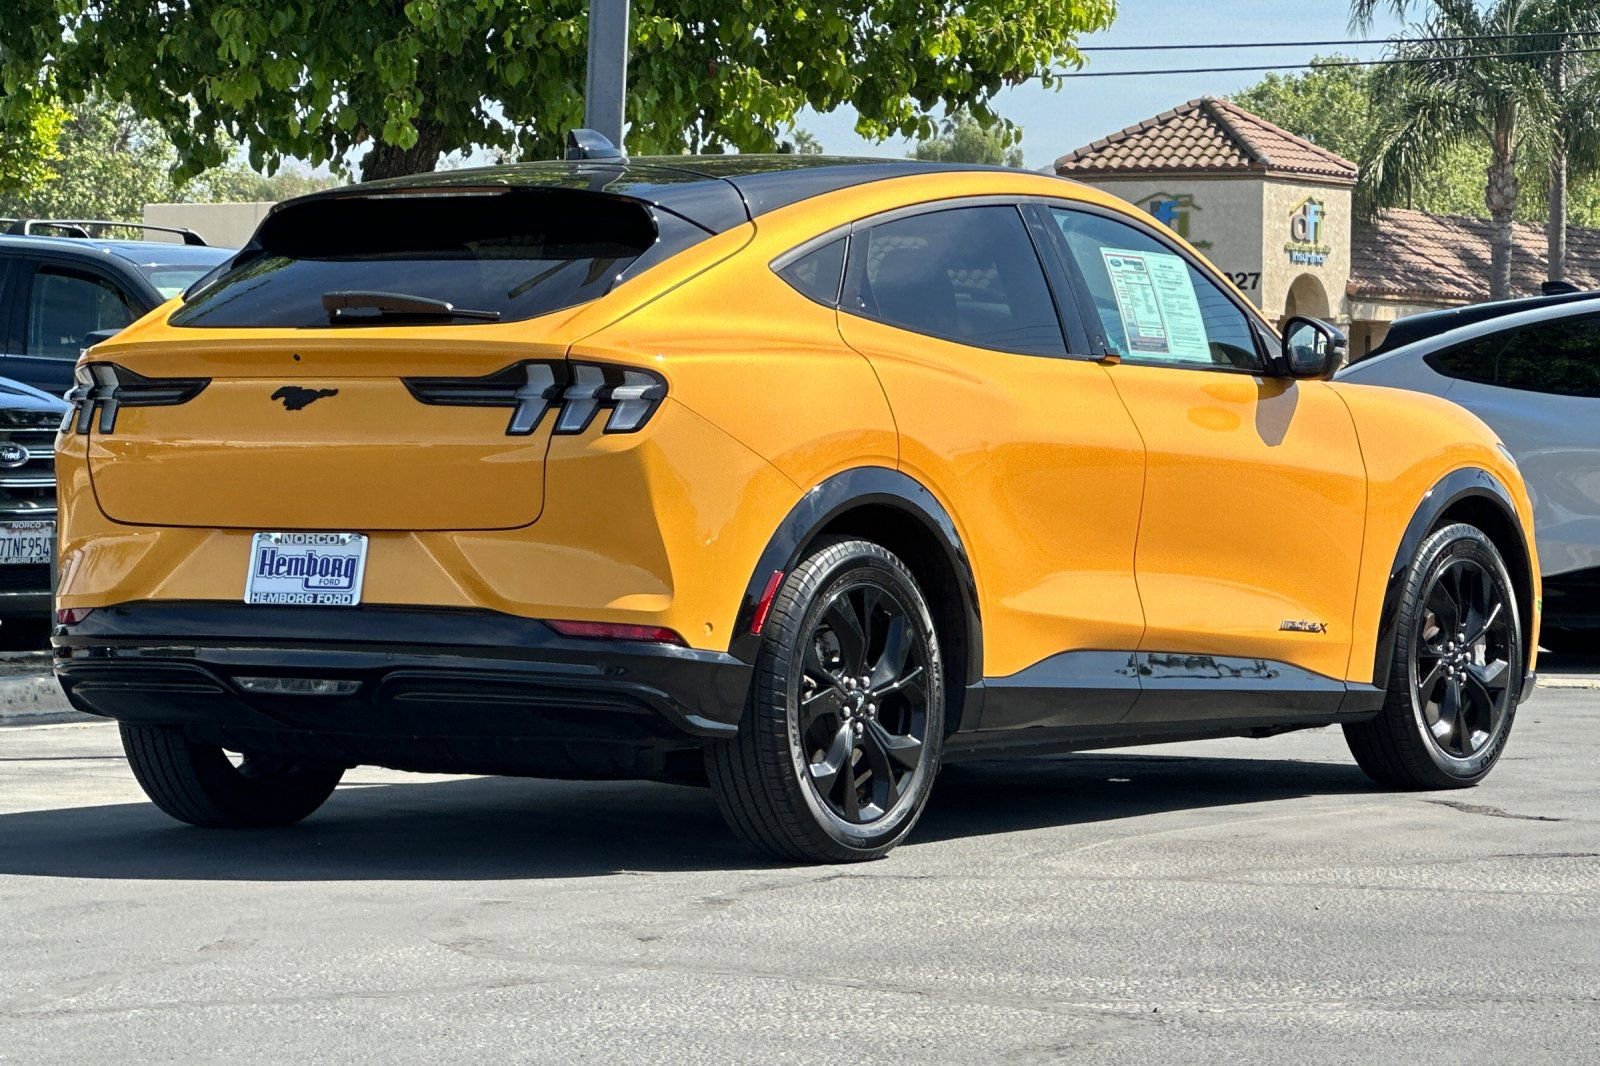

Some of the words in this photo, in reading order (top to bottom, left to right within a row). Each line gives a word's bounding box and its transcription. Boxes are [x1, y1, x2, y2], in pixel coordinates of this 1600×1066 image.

[281, 533, 340, 545] NORCO
[0, 537, 50, 557] 7TNF954
[258, 547, 358, 581] Hemborg
[319, 578, 341, 586] FORD
[251, 592, 314, 604] HEMBORG
[316, 593, 352, 605] FORD
